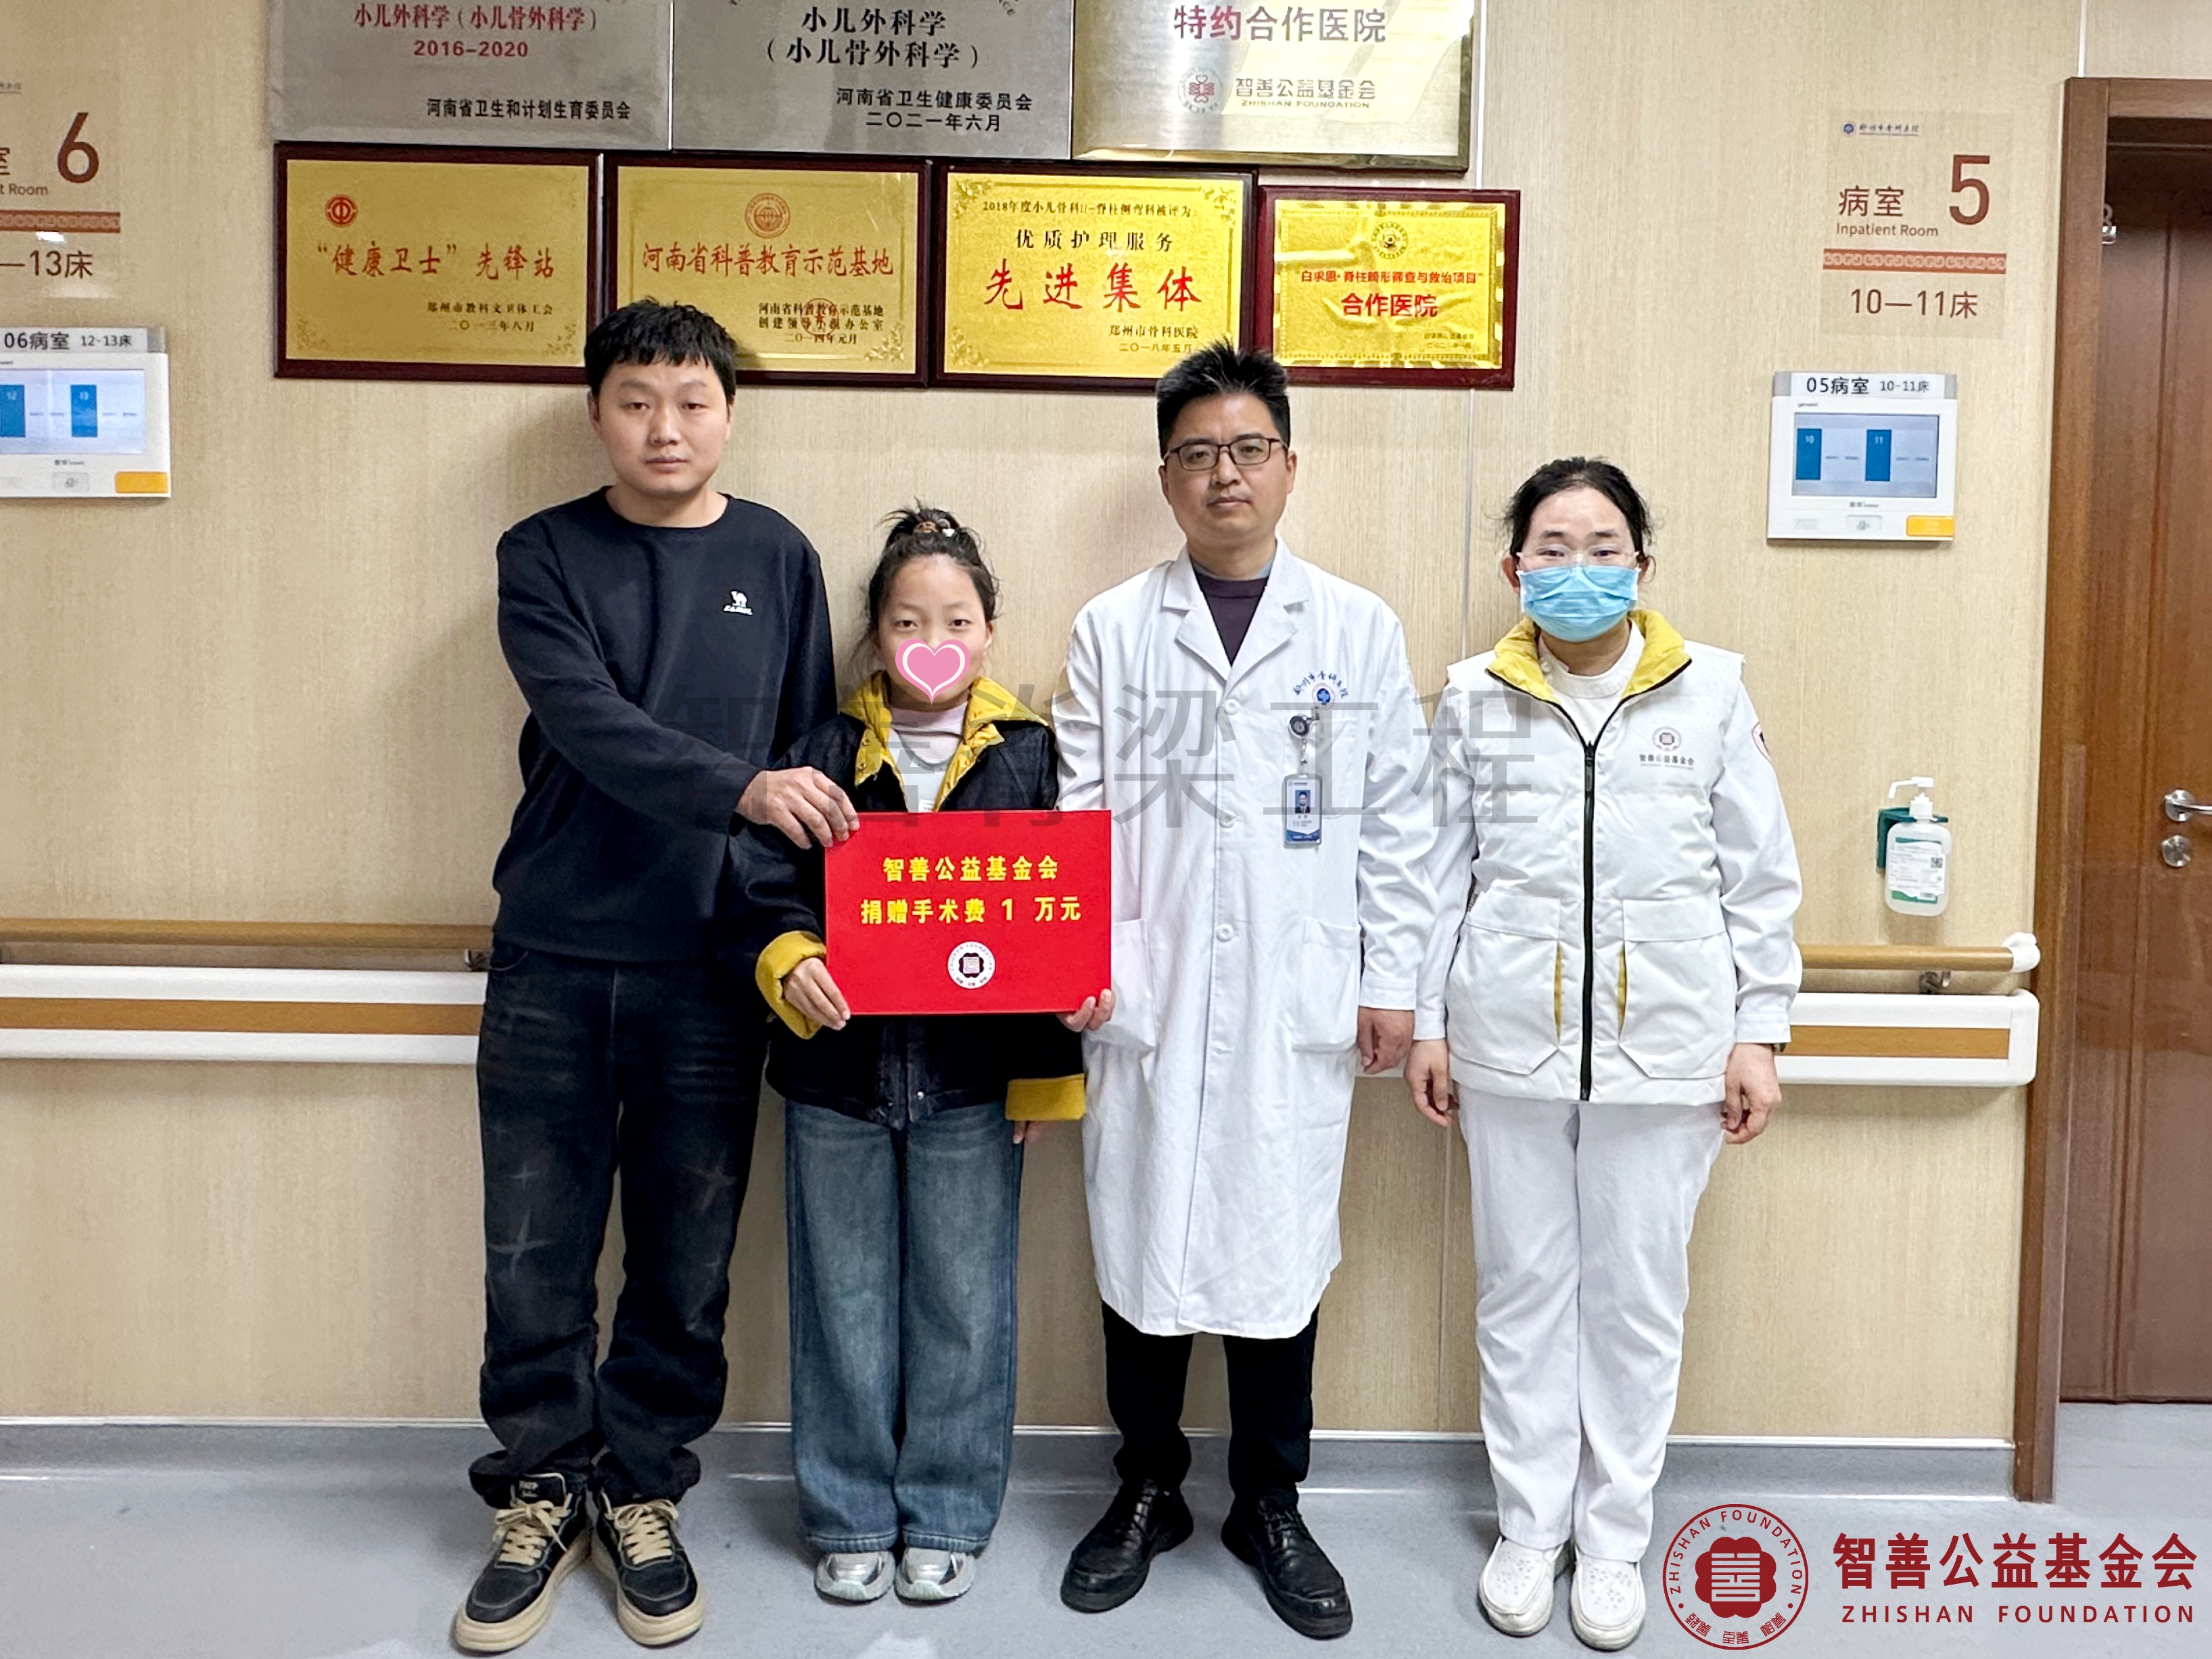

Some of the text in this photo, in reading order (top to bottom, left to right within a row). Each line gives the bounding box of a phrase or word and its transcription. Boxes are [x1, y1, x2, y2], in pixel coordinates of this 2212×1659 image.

[801, 7, 946, 37] 小儿外科学
[1173, 5, 1386, 43] 特约合作医院
[766, 37, 979, 68] （小儿骨外科学）
[836, 87, 1033, 112] 河南省卫生健康委员会
[1235, 78, 1375, 99] 智善公益基金会
[426, 98, 631, 120] 河南省卫生和计划生育委员会
[1296, 101, 1370, 109] FOUNDATION
[57, 112, 99, 184] 6
[9, 183, 49, 196] Room
[1837, 154, 1990, 225] 病室 5
[1016, 229, 1173, 252] 优质护理服务
[1836, 222, 1939, 237] Inpatient Room
[642, 241, 894, 277] 河南省科普教育示范基地
[983, 258, 1203, 313] 先进集体
[1341, 293, 1438, 317] 合作医院
[4, 331, 70, 350] 06病室
[1110, 324, 1199, 339] 郑州市骨科医院
[1806, 376, 1929, 395] 05病室 10-11床
[883, 856, 1058, 882] 智善公益基金会
[861, 896, 1081, 925] 捐赠手术费 1 万元
